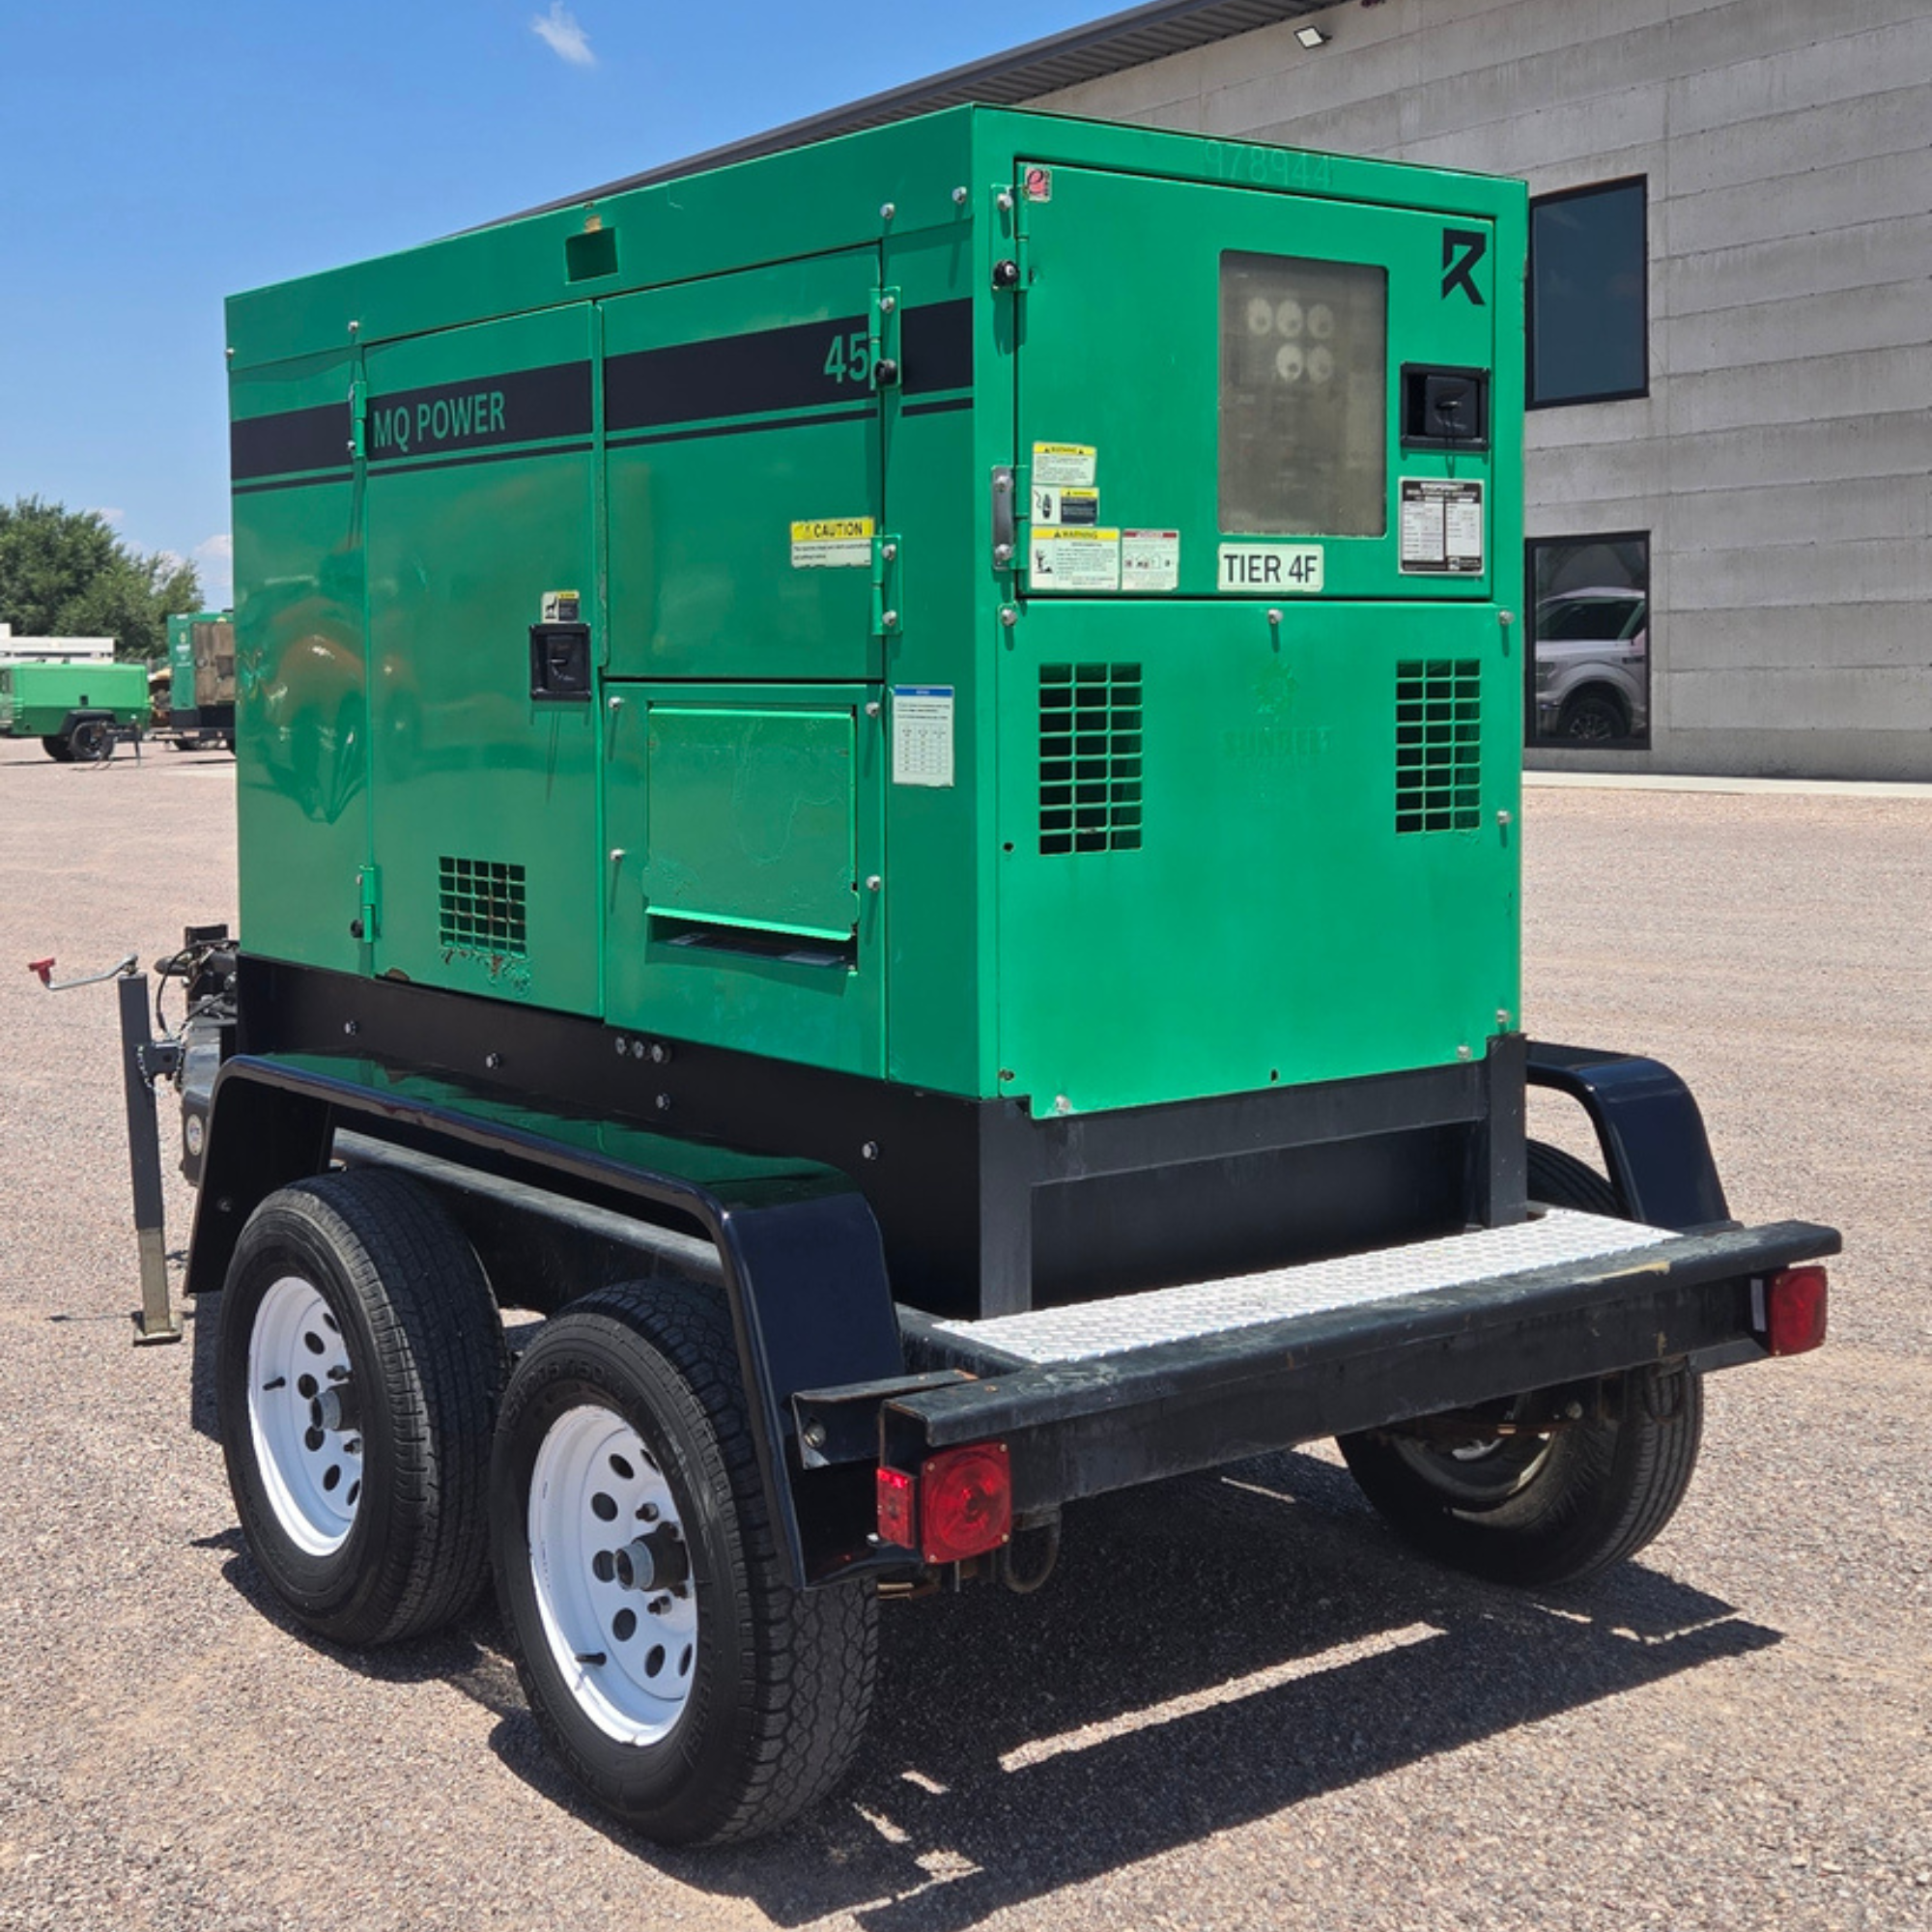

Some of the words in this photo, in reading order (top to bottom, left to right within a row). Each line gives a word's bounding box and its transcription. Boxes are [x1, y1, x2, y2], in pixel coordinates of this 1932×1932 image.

[824, 331, 868, 383] 45
[374, 406, 411, 452] MQ
[417, 390, 505, 442] POWER
[813, 522, 864, 538] CAUTION
[1223, 554, 1282, 583] TIER
[1288, 554, 1319, 583] 4F
